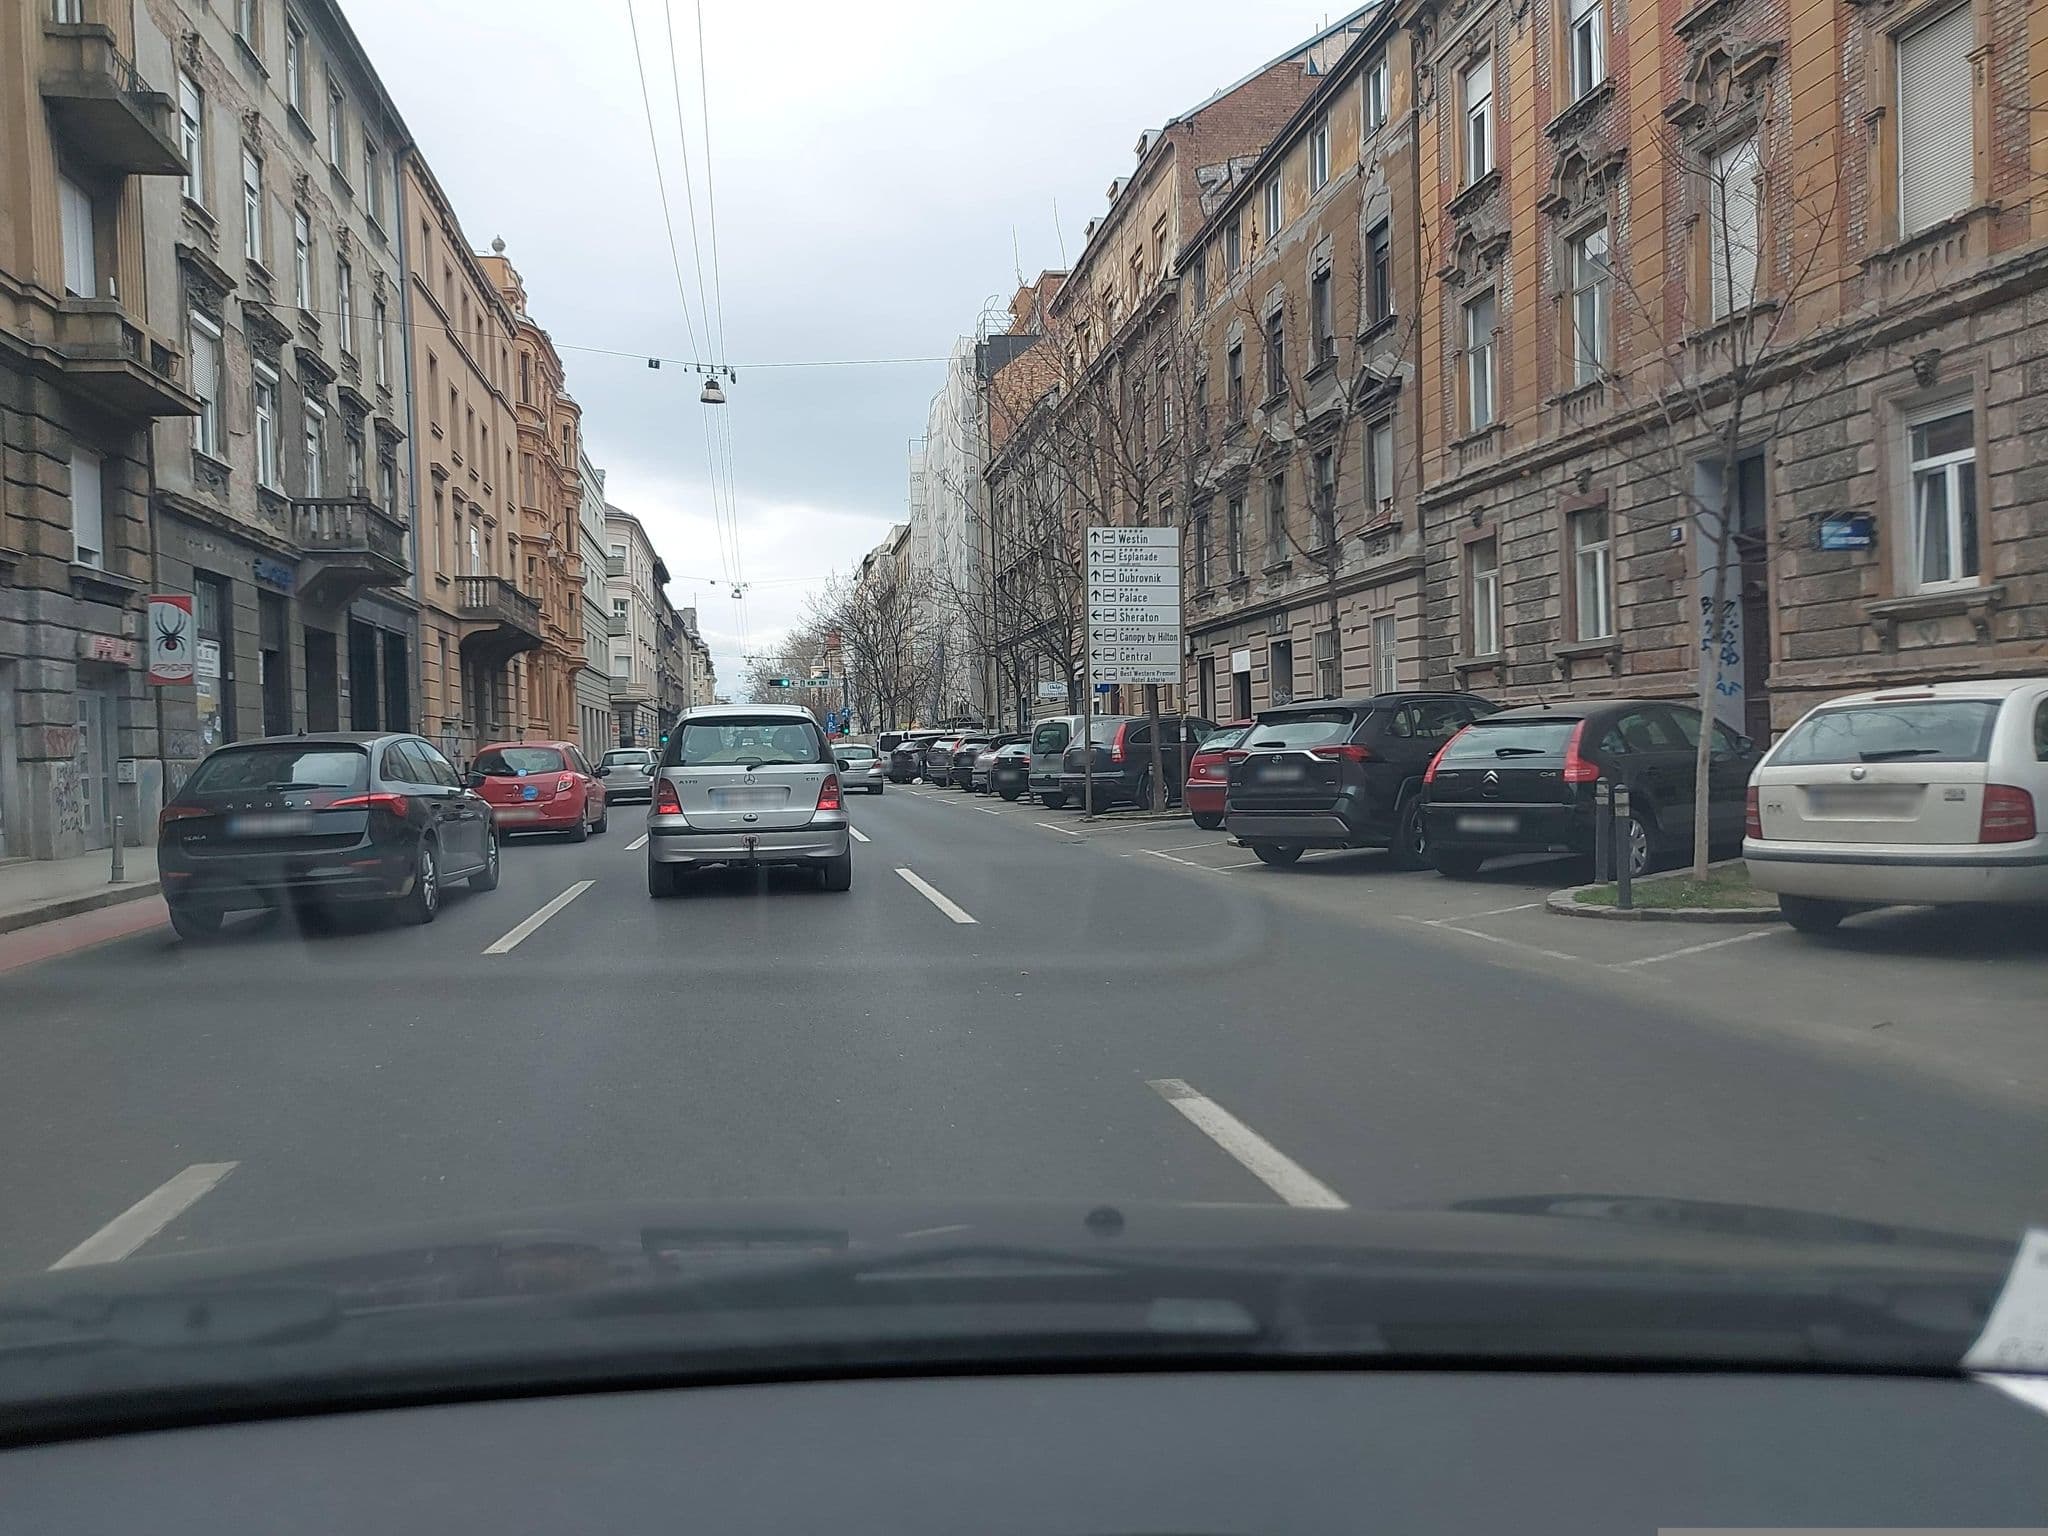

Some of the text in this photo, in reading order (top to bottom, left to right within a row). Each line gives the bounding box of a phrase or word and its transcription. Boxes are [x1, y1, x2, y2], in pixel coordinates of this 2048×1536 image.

[1119, 534, 1148, 544] Westin
[1119, 552, 1158, 563] Esplanade
[1119, 573, 1161, 583] Dubrovnik
[1120, 593, 1147, 602] Palace
[1120, 612, 1159, 622] Sheraton
[1120, 632, 1178, 643] Canopy by Hilton
[1120, 652, 1151, 661] Central
[152, 664, 192, 672] SPYDER
